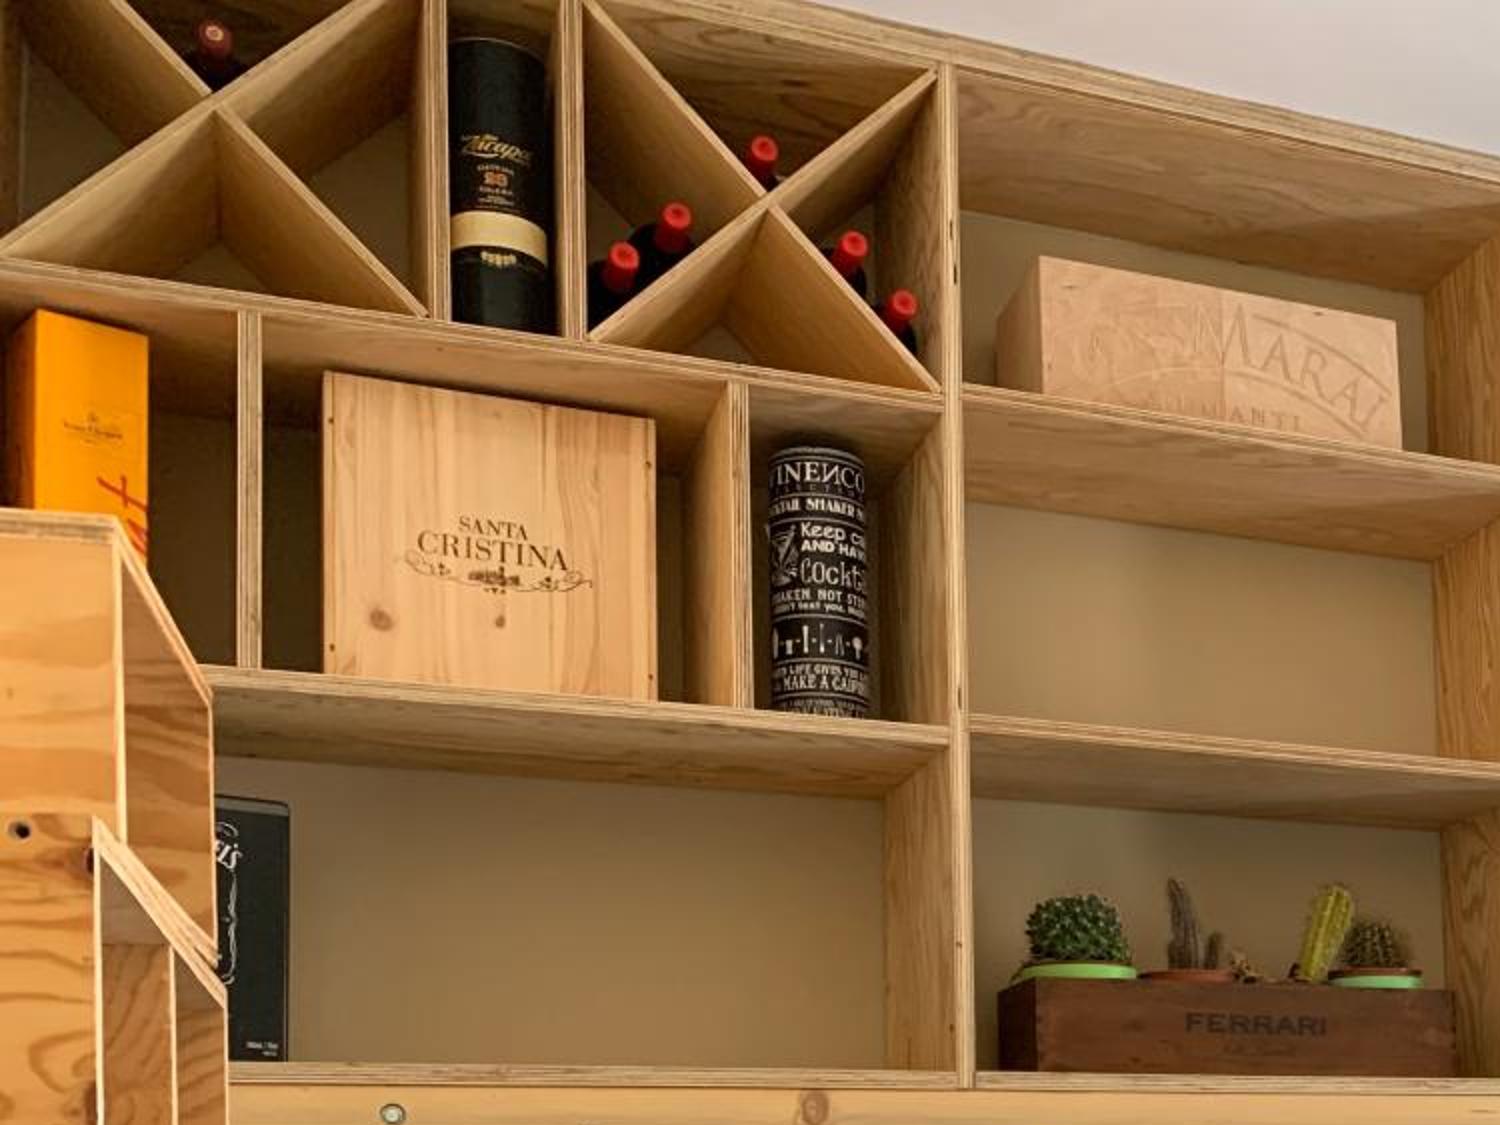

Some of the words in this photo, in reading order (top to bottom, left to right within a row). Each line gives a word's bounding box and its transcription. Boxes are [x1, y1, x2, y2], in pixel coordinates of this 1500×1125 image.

[458, 516, 528, 541] SANTA
[417, 530, 568, 571] CRISTINA
[801, 539, 835, 552] AND
[817, 589, 842, 602] NOT
[1184, 1011, 1327, 1037] FERRARI
